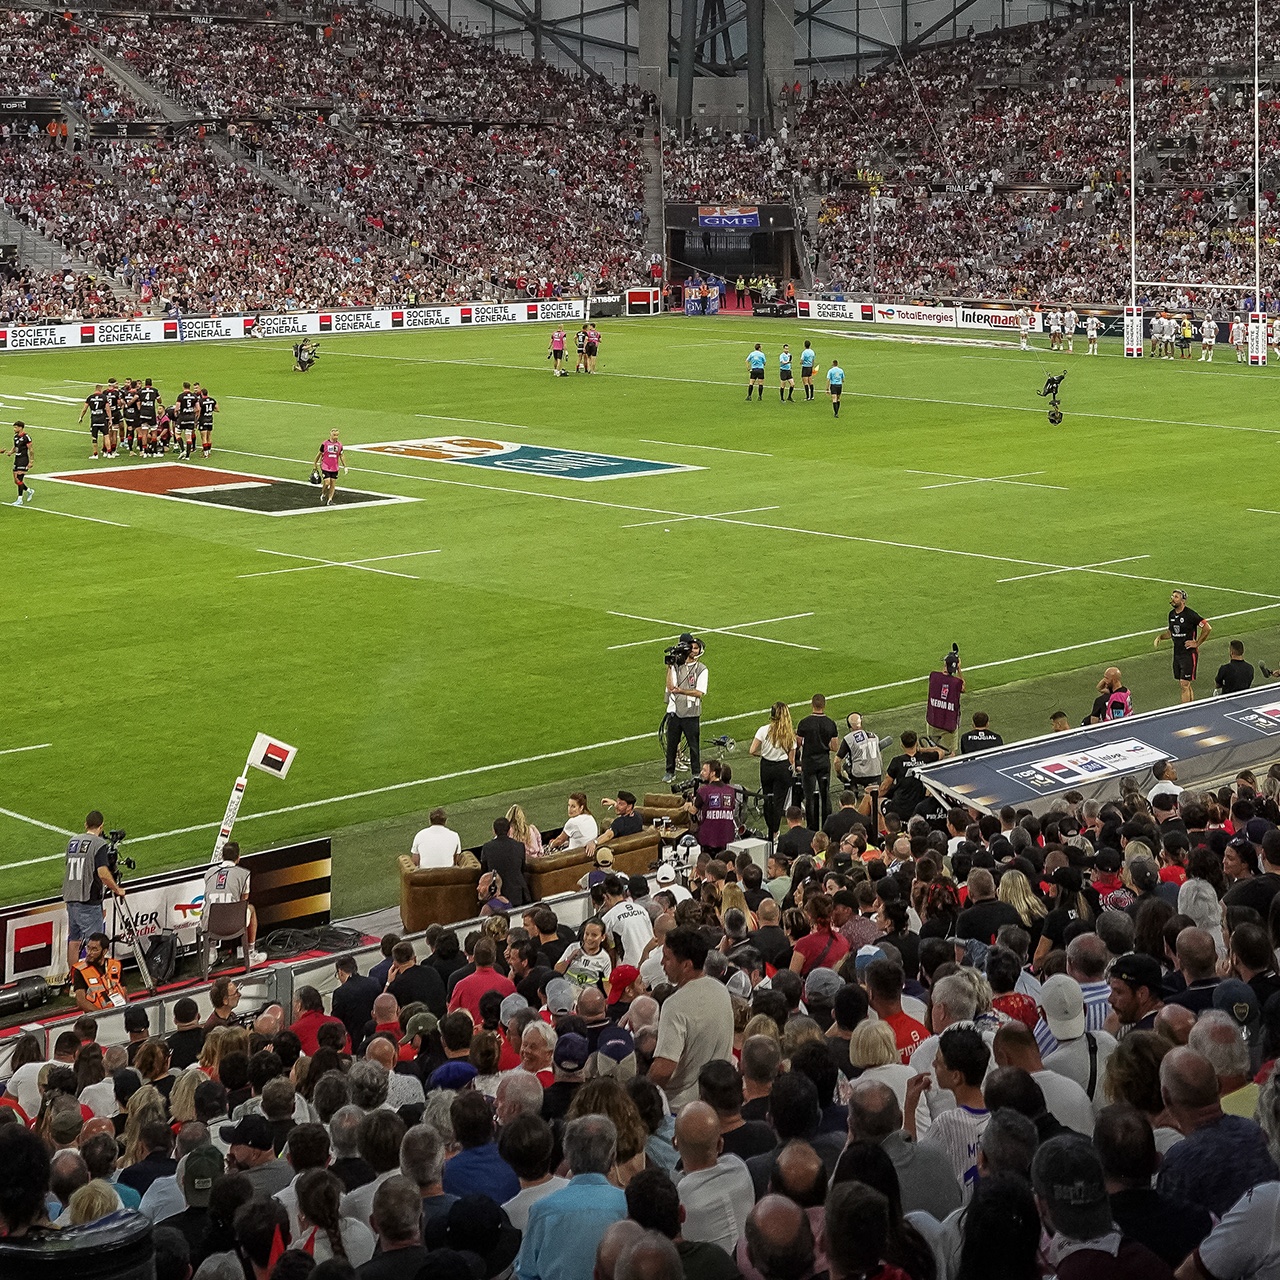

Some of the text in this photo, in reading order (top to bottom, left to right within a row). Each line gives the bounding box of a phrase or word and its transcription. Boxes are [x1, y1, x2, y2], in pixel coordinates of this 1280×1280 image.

[945, 184, 969, 192] FINALE
[704, 217, 755, 226] GMF
[597, 295, 621, 303] TISSOT
[475, 306, 506, 315] SOCIETE
[540, 302, 573, 312] SOCIETE
[817, 304, 847, 312] SOCIETE
[335, 313, 370, 322] SOCIETE
[407, 310, 438, 319] SOCIETE
[475, 313, 517, 322] GENERALE
[541, 309, 580, 318] GENERALE
[817, 310, 854, 319] GENERALE
[897, 310, 954, 324] TotalEnergies
[181, 320, 222, 330] SOCIETE
[260, 317, 299, 326] SOCIETE
[335, 321, 381, 331] GENERALE
[407, 317, 450, 327] GENERALE
[99, 323, 142, 333] SOCIETE
[181, 327, 231, 338] GENERALE
[11, 328, 56, 338] SOCIETE
[98, 331, 151, 342] GENERALE
[11, 336, 66, 347] GENERALE
[145, 392, 150, 401] 4
[94, 401, 99, 410] 7
[187, 399, 192, 408] 5
[205, 403, 213, 412] 14
[1013, 769, 1036, 778] TOP
